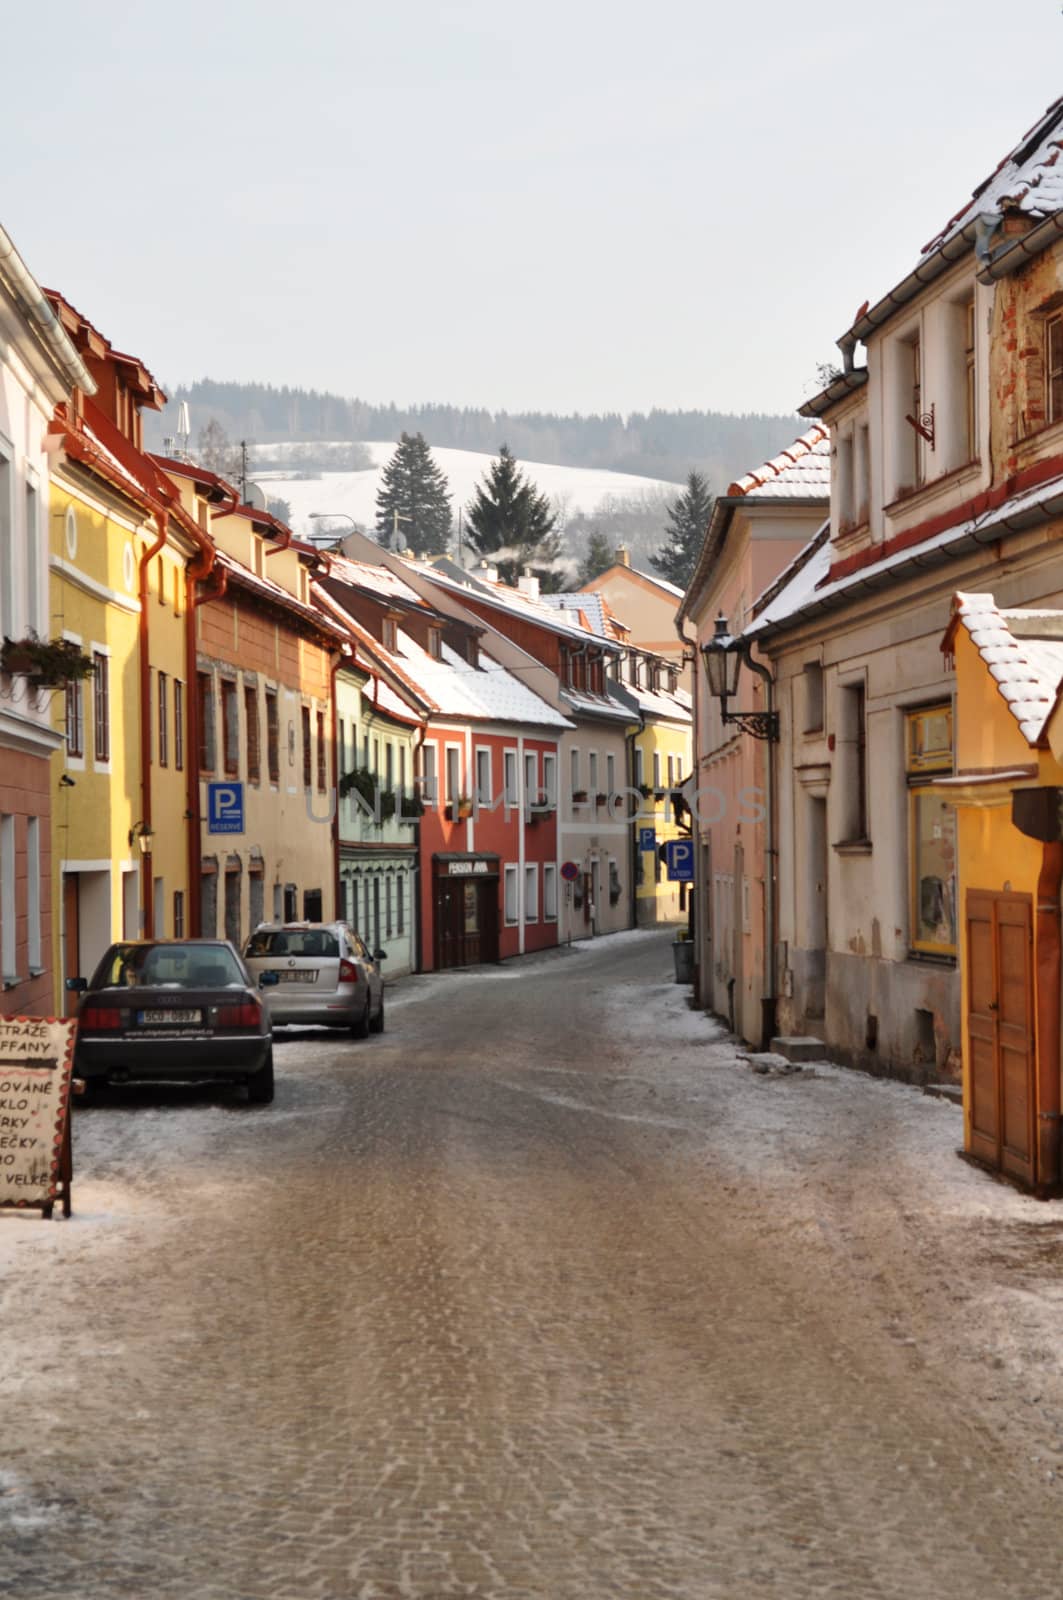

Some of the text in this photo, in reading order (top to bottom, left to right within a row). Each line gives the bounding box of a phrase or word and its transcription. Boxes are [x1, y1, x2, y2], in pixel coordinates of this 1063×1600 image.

[215, 789, 236, 819] P
[642, 830, 652, 844] P
[673, 845, 689, 869] P
